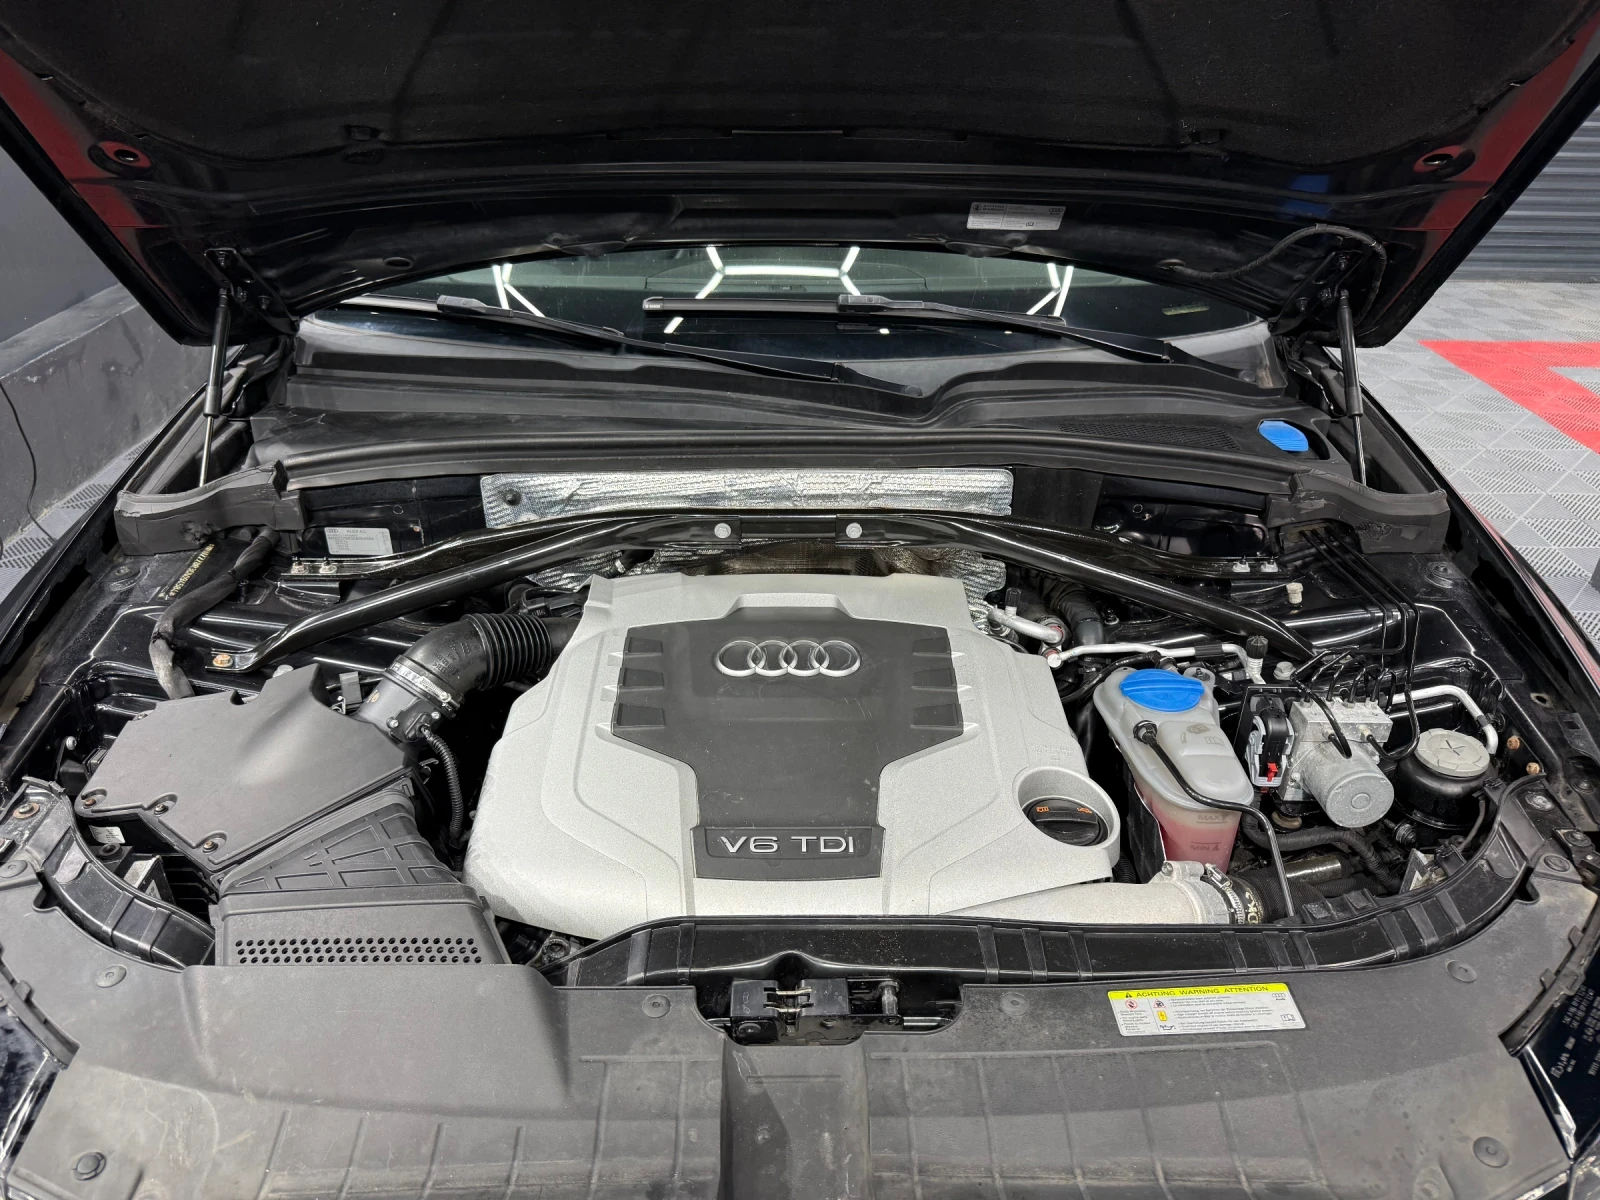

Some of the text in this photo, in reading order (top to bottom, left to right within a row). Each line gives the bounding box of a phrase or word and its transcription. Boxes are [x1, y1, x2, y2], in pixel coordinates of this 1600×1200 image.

[720, 836, 854, 853] V6 TDI
[1136, 990, 1176, 998] ACHTUNG
[1179, 987, 1220, 996] WARNING
[1224, 985, 1269, 994] ATTENTION
